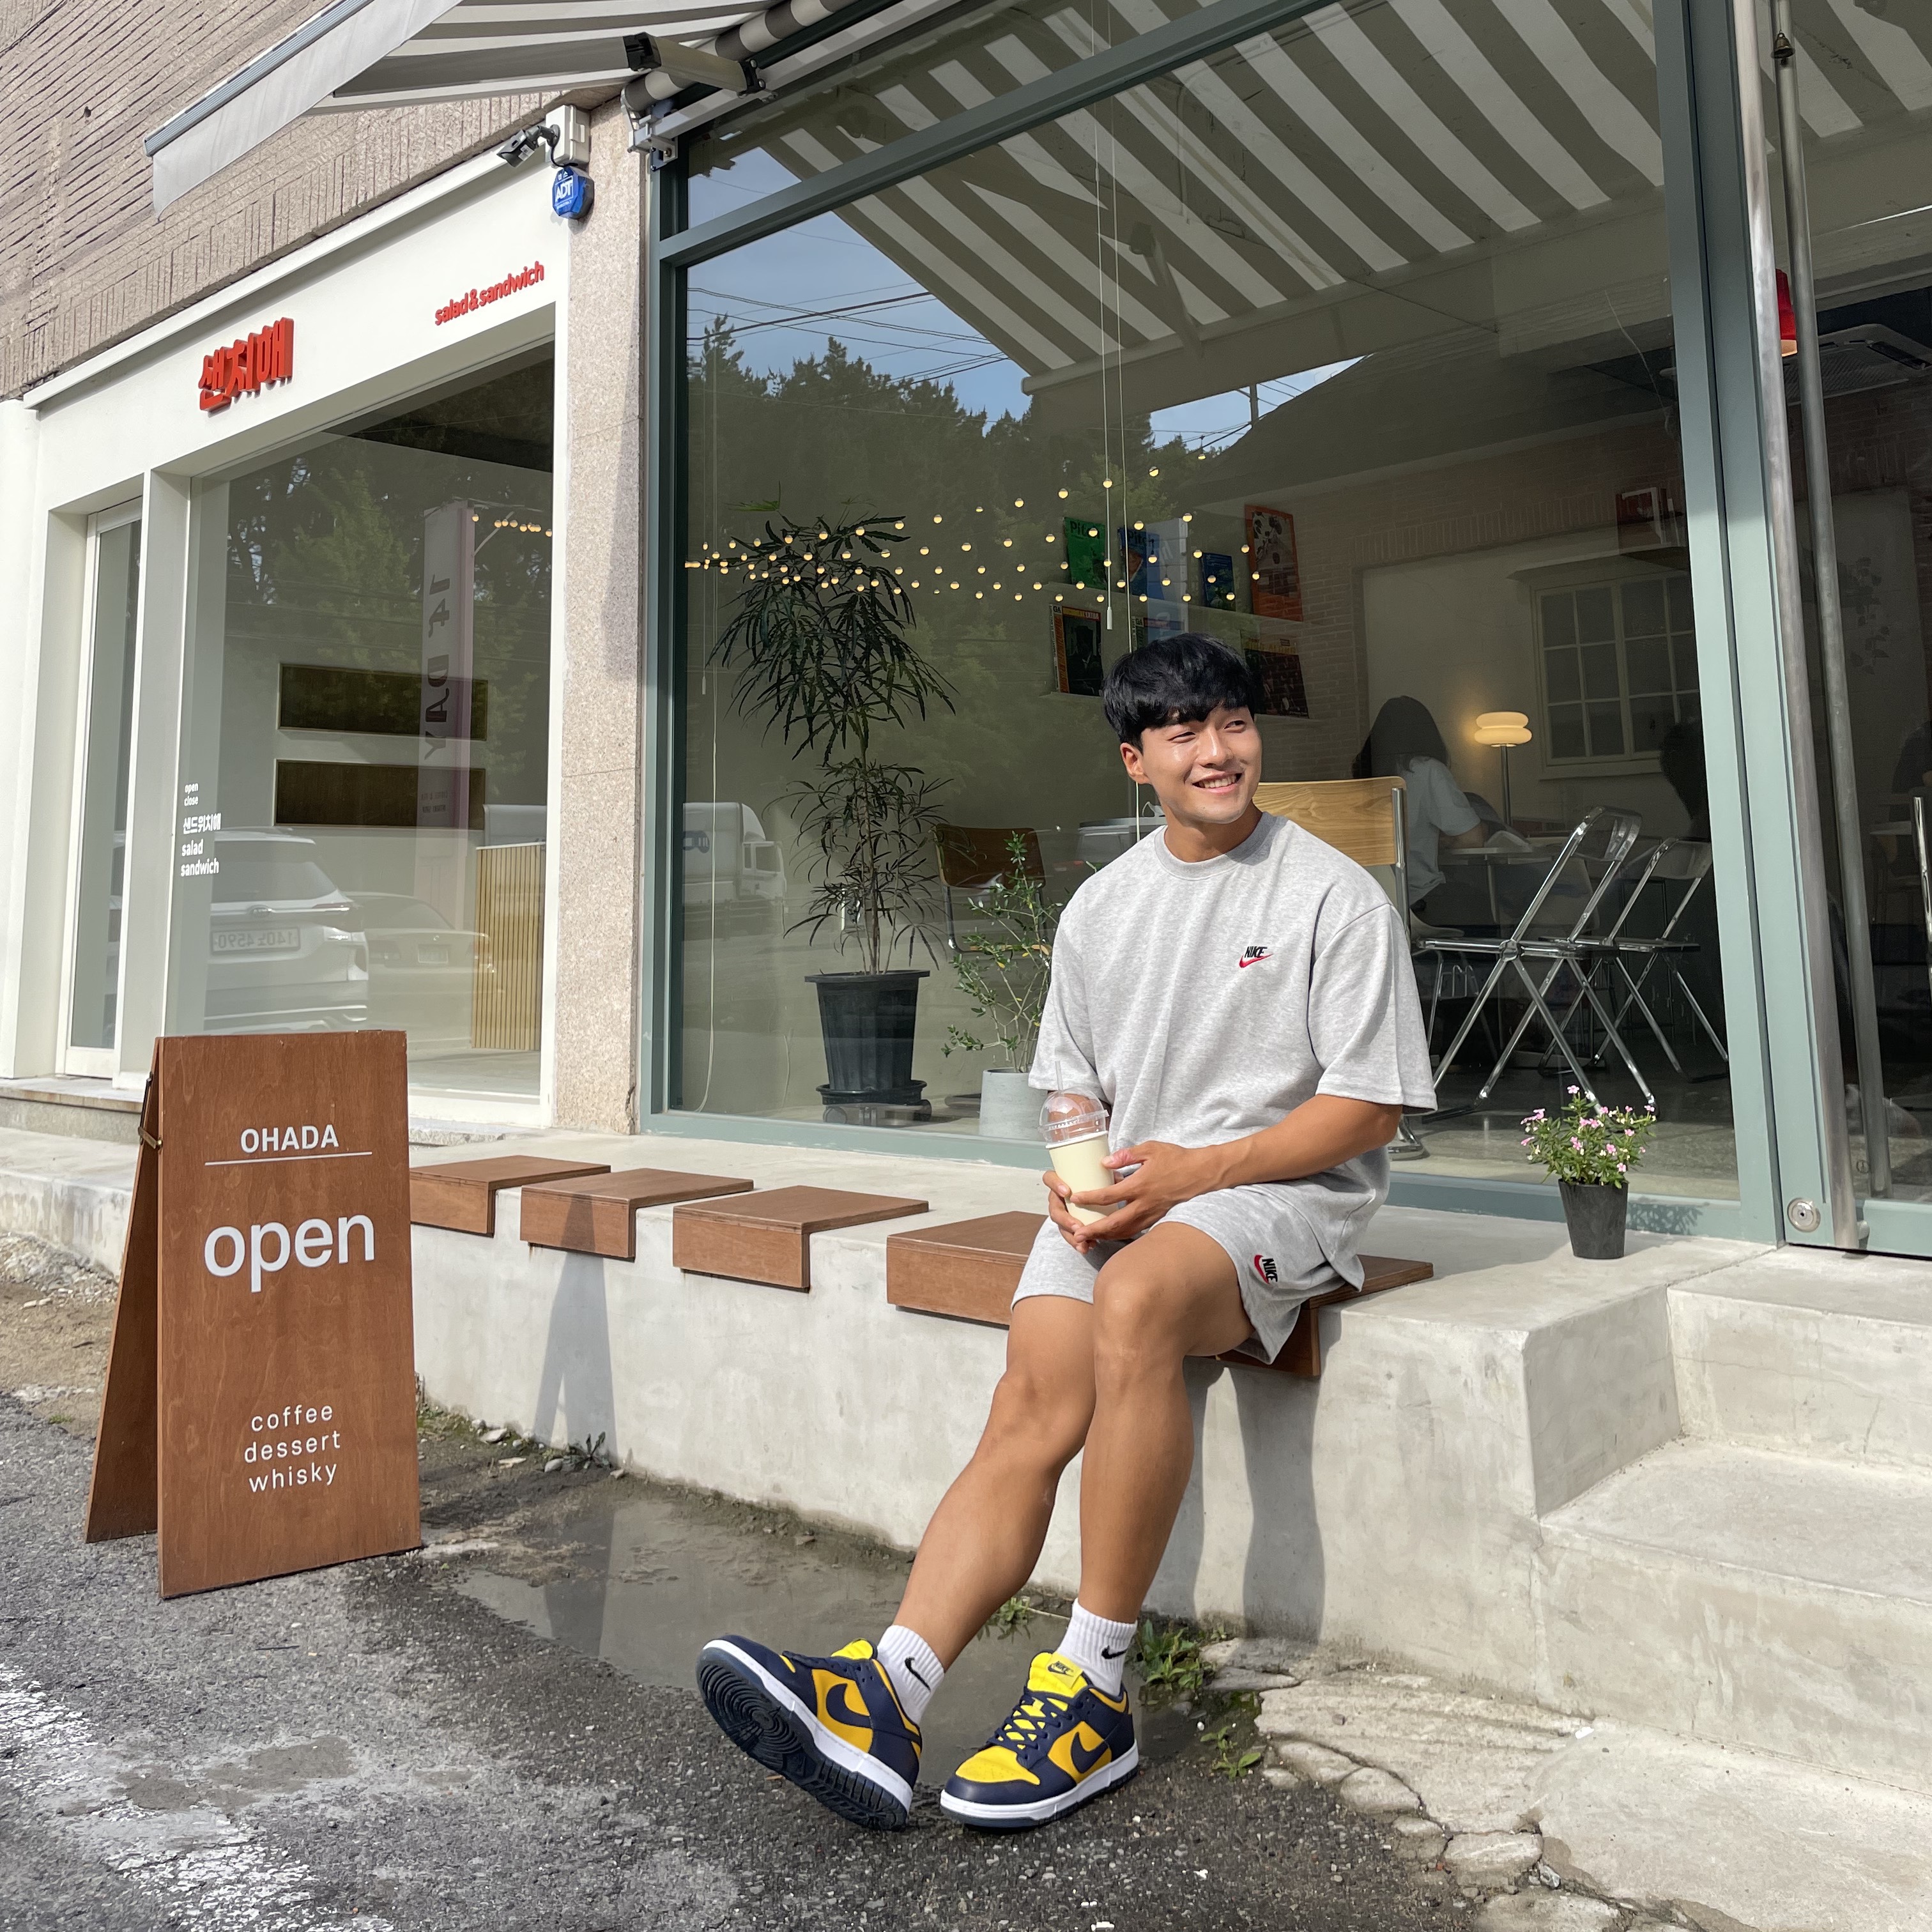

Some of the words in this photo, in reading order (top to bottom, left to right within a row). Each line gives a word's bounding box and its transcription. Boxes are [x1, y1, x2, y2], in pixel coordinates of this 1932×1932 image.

[555, 180, 573, 203] ADT
[184, 795, 199, 806] close
[185, 783, 199, 794] open
[181, 838, 204, 857] salad
[180, 857, 220, 877] sandwich
[1245, 946, 1268, 958] NIKE
[240, 1124, 340, 1154] OHADA
[204, 1214, 376, 1293] open
[1262, 1257, 1278, 1282] NIKE
[250, 1404, 333, 1432] coffee
[244, 1430, 341, 1464] dessert
[249, 1462, 337, 1493] whisky
